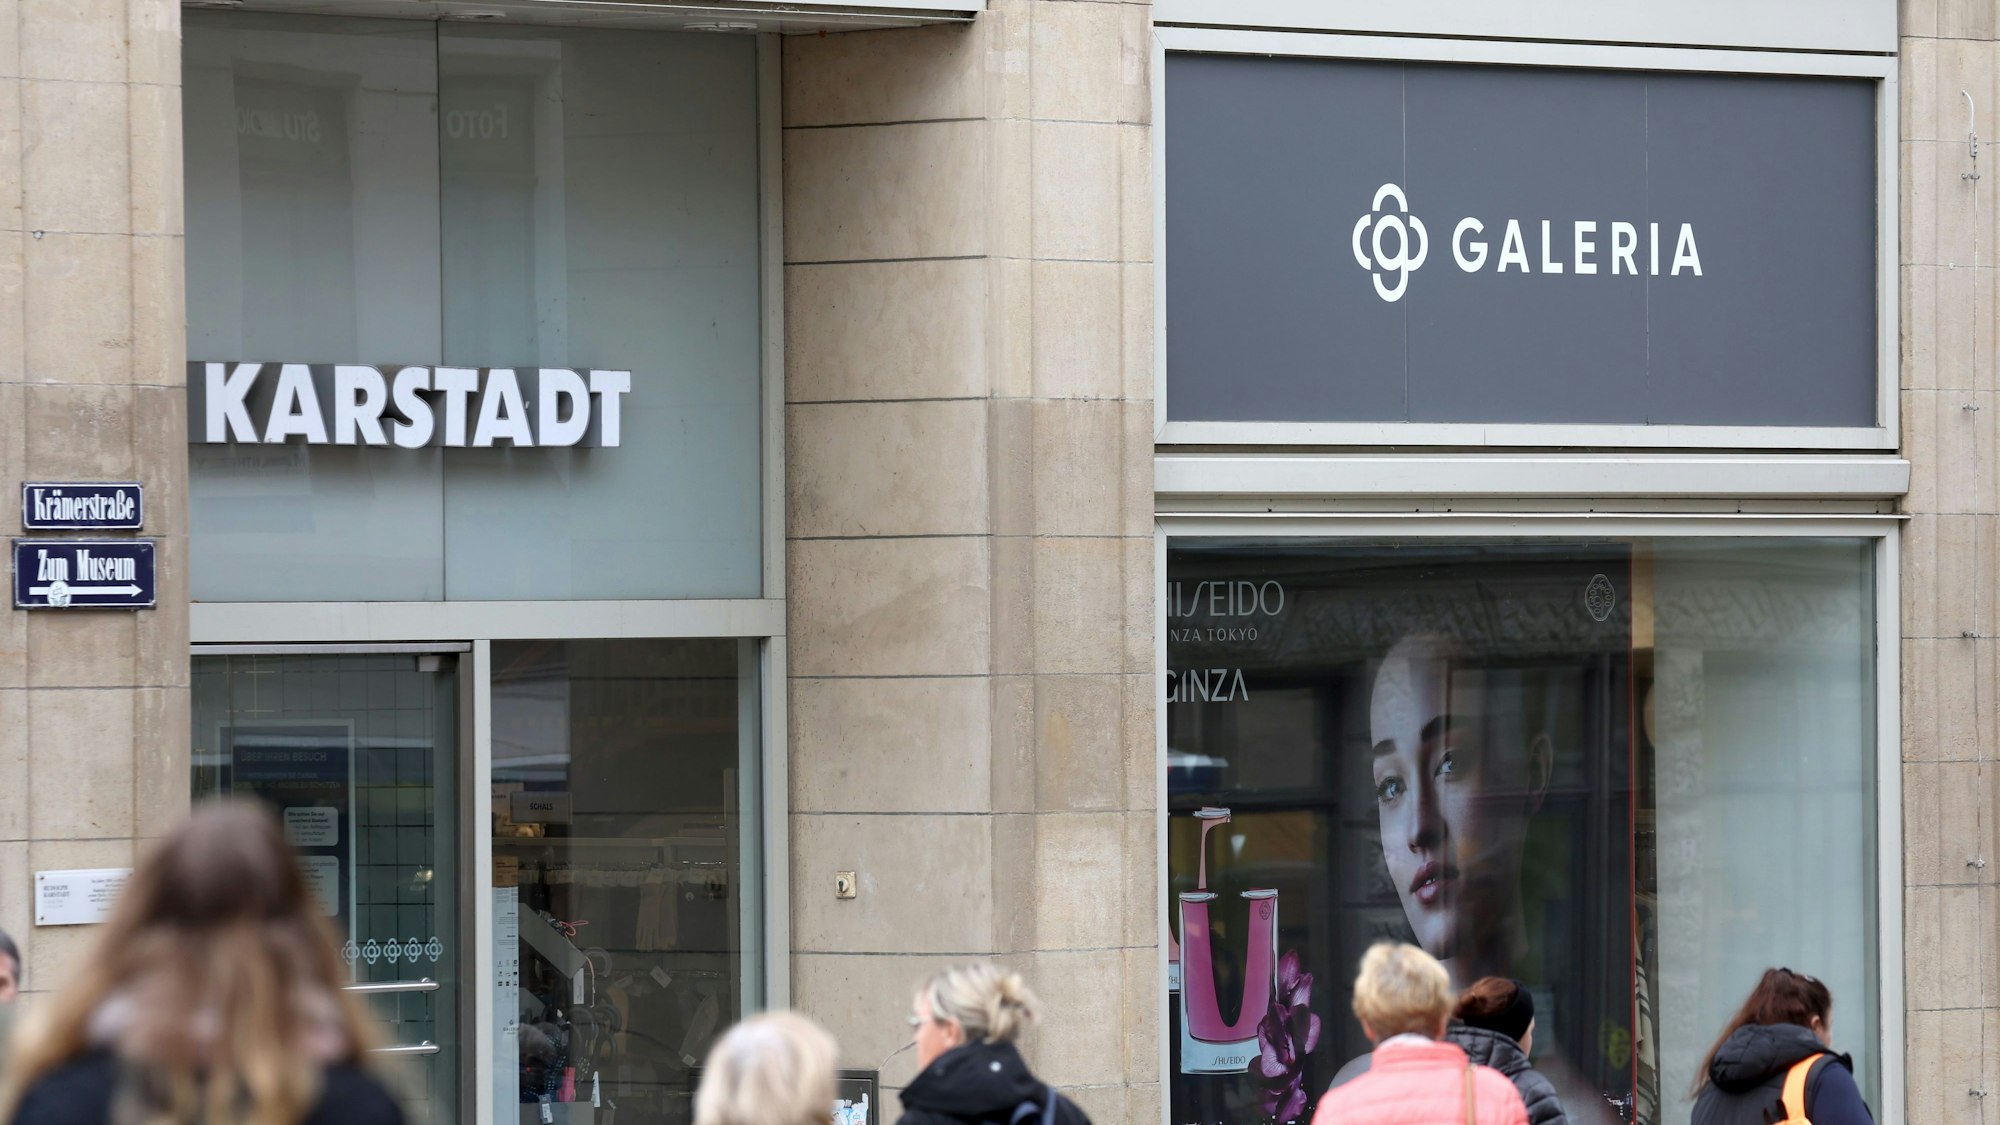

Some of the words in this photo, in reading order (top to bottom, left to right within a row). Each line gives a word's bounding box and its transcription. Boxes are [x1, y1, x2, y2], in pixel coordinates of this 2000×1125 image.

[1452, 217, 1703, 276] GALERIA
[206, 362, 631, 449] KARSTADT
[33, 488, 135, 521] Krämerstraße
[37, 549, 69, 581] Zum
[76, 549, 136, 581] Museum
[1170, 628, 1202, 642] NZA
[1207, 628, 1258, 641] TOKYO
[529, 802, 553, 811] SCHALS
[1212, 1055, 1246, 1066] SHISEIDO
